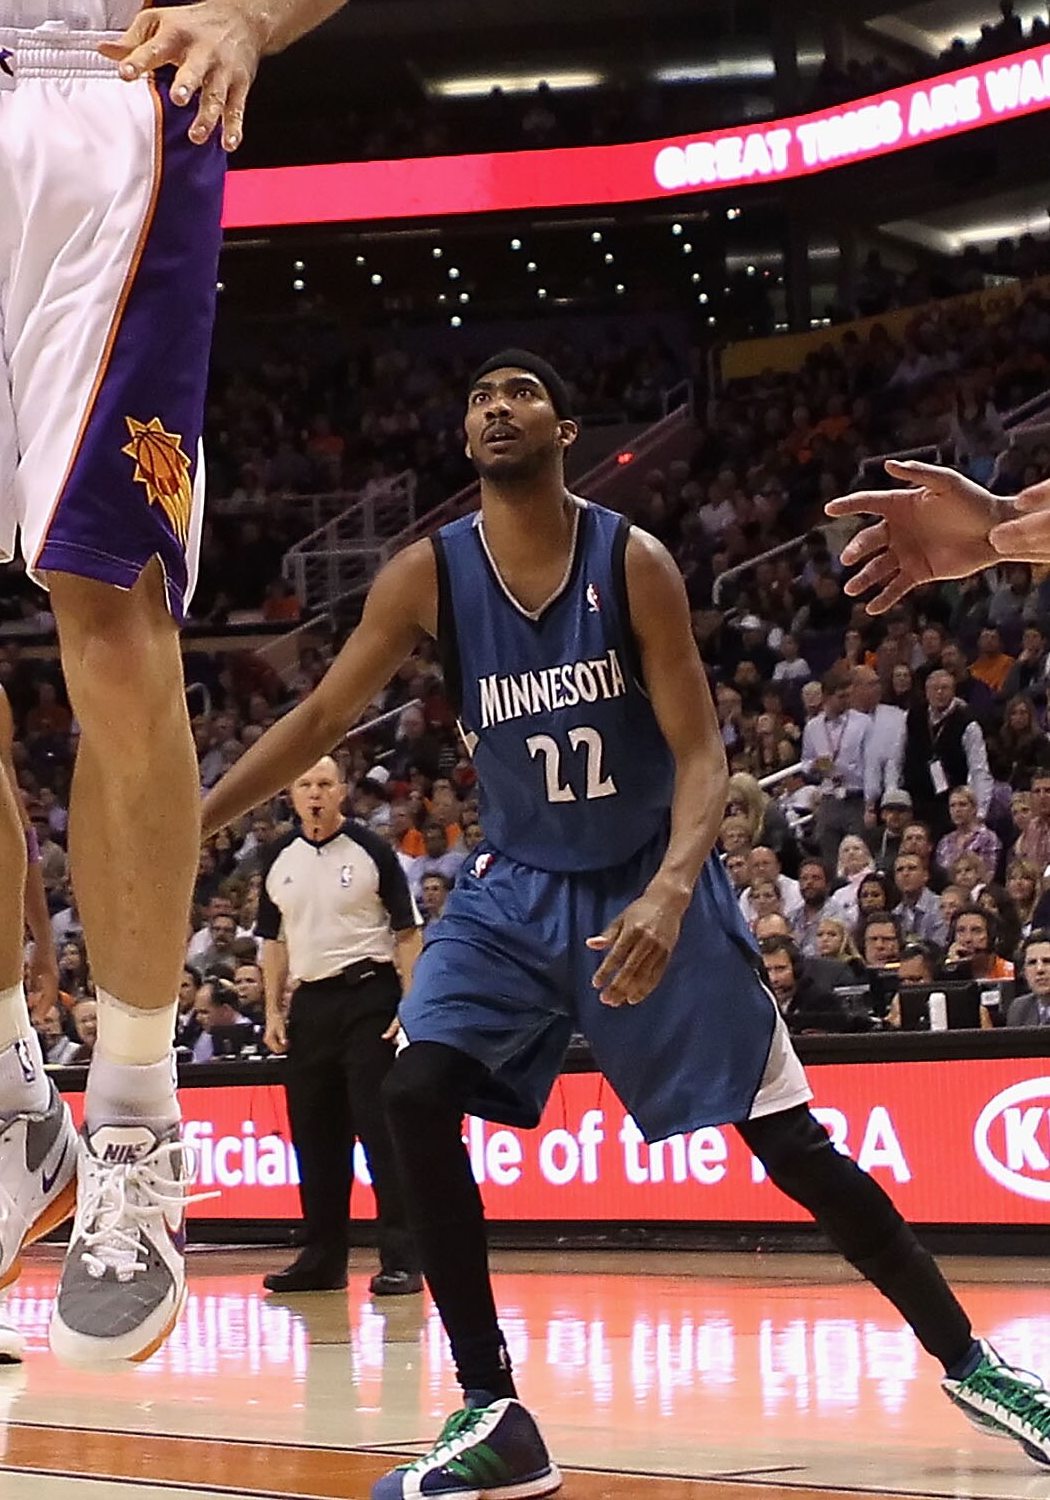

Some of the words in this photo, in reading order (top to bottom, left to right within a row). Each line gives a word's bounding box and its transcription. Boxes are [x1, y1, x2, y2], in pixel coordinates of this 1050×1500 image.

[654, 128, 792, 190] GREAT
[907, 76, 982, 137] ARE
[478, 650, 627, 729] MINNESOTA
[526, 726, 618, 803] 22
[539, 1108, 603, 1184] of
